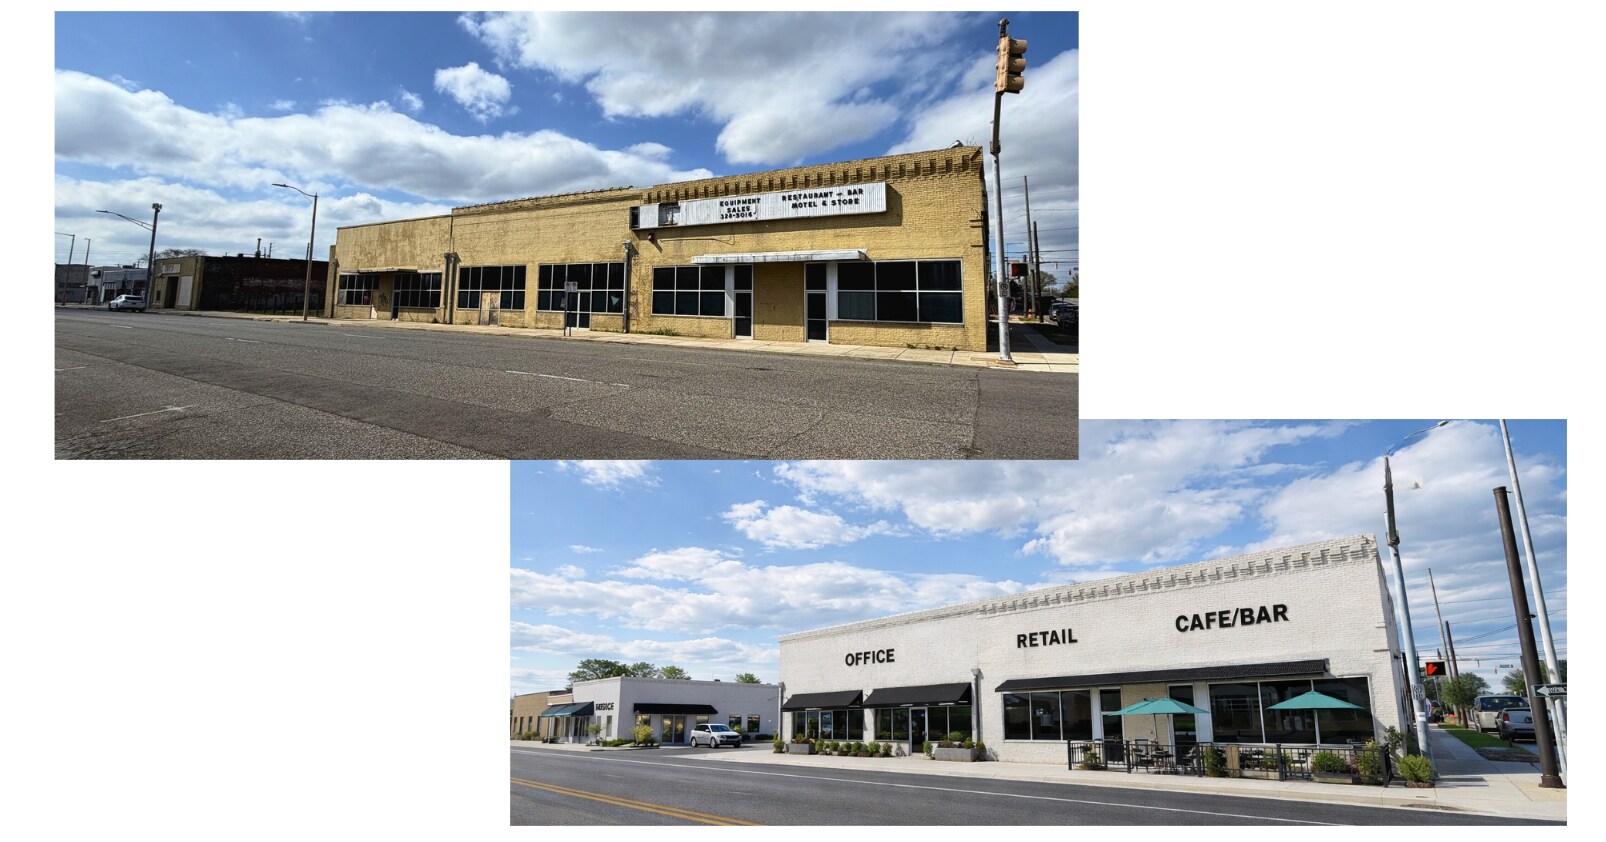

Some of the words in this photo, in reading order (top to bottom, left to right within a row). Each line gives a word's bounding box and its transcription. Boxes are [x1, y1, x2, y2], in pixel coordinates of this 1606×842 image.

[720, 198, 761, 207] EQUIPMENT
[782, 191, 833, 201] RESTAURANT
[847, 188, 863, 196] BAR
[791, 201, 817, 209] MOTEL
[831, 198, 860, 206] STORE
[1175, 604, 1290, 633] CAFE/BAR
[1016, 628, 1078, 649] RETAIL
[845, 648, 895, 667] OFFICE
